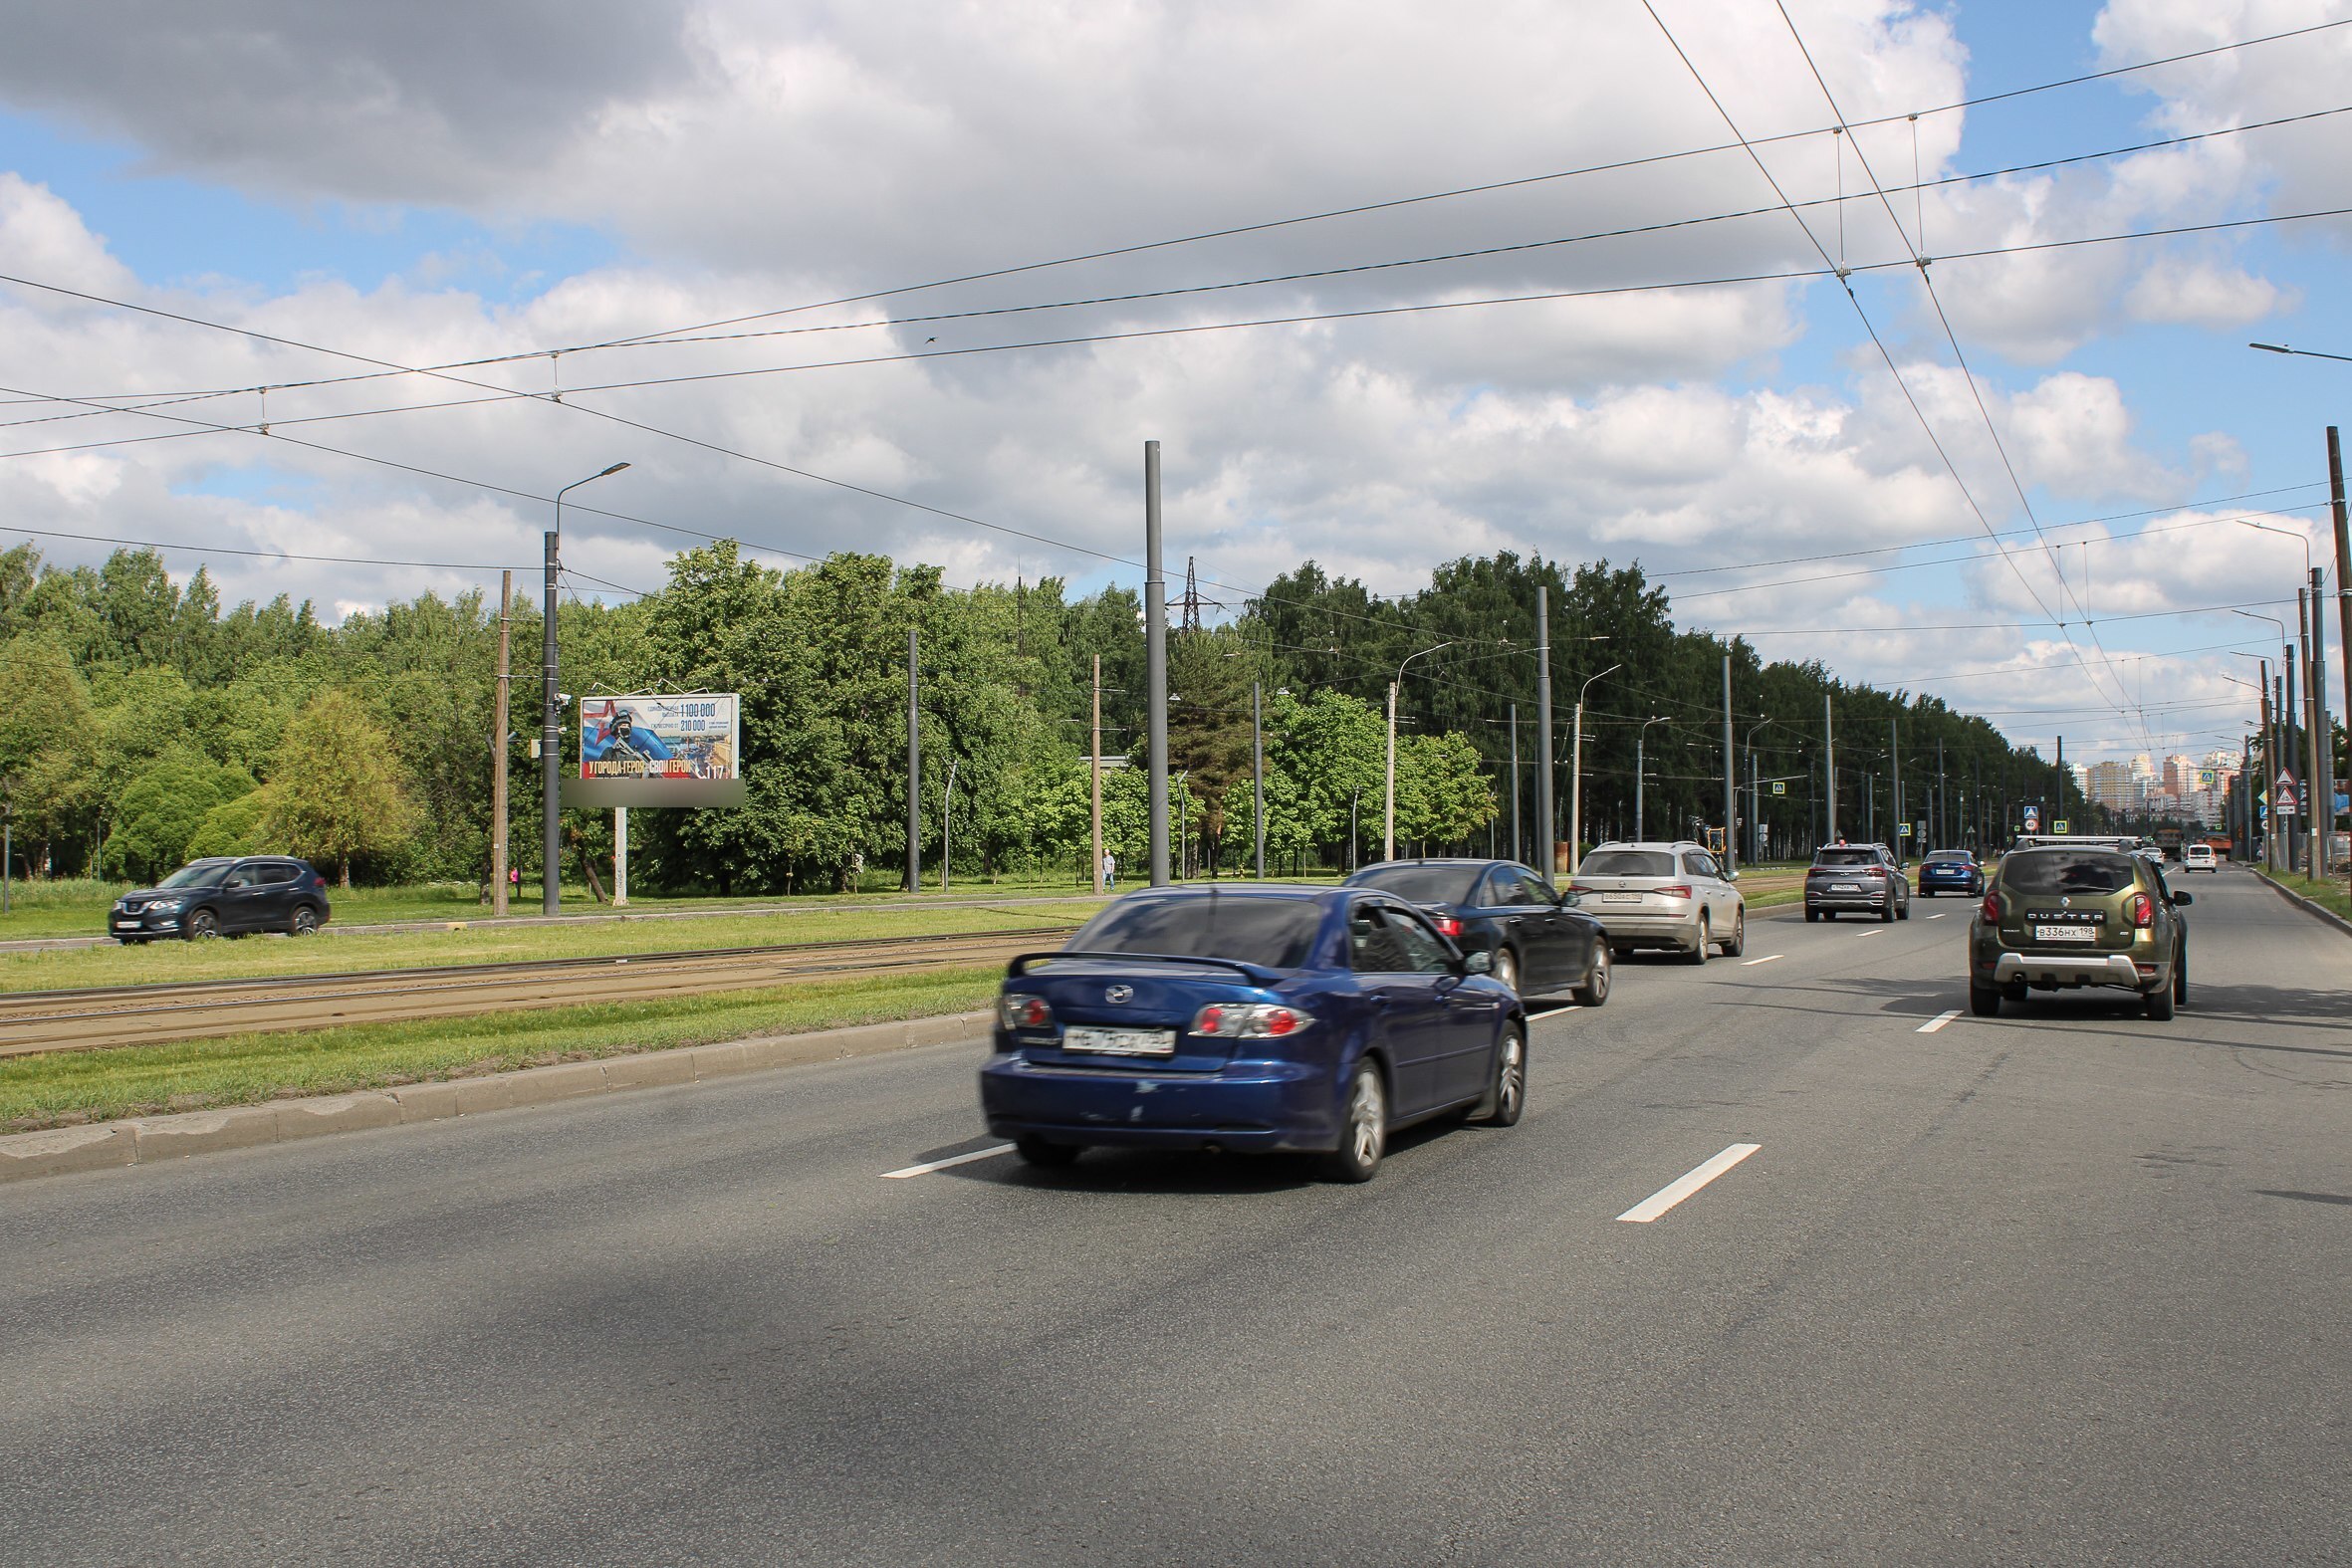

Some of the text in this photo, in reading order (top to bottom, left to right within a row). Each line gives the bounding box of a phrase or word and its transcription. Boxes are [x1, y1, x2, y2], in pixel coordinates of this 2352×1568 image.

[681, 720, 692, 731] 210
[588, 761, 594, 775] У
[2039, 927, 2077, 937] В336НХ
